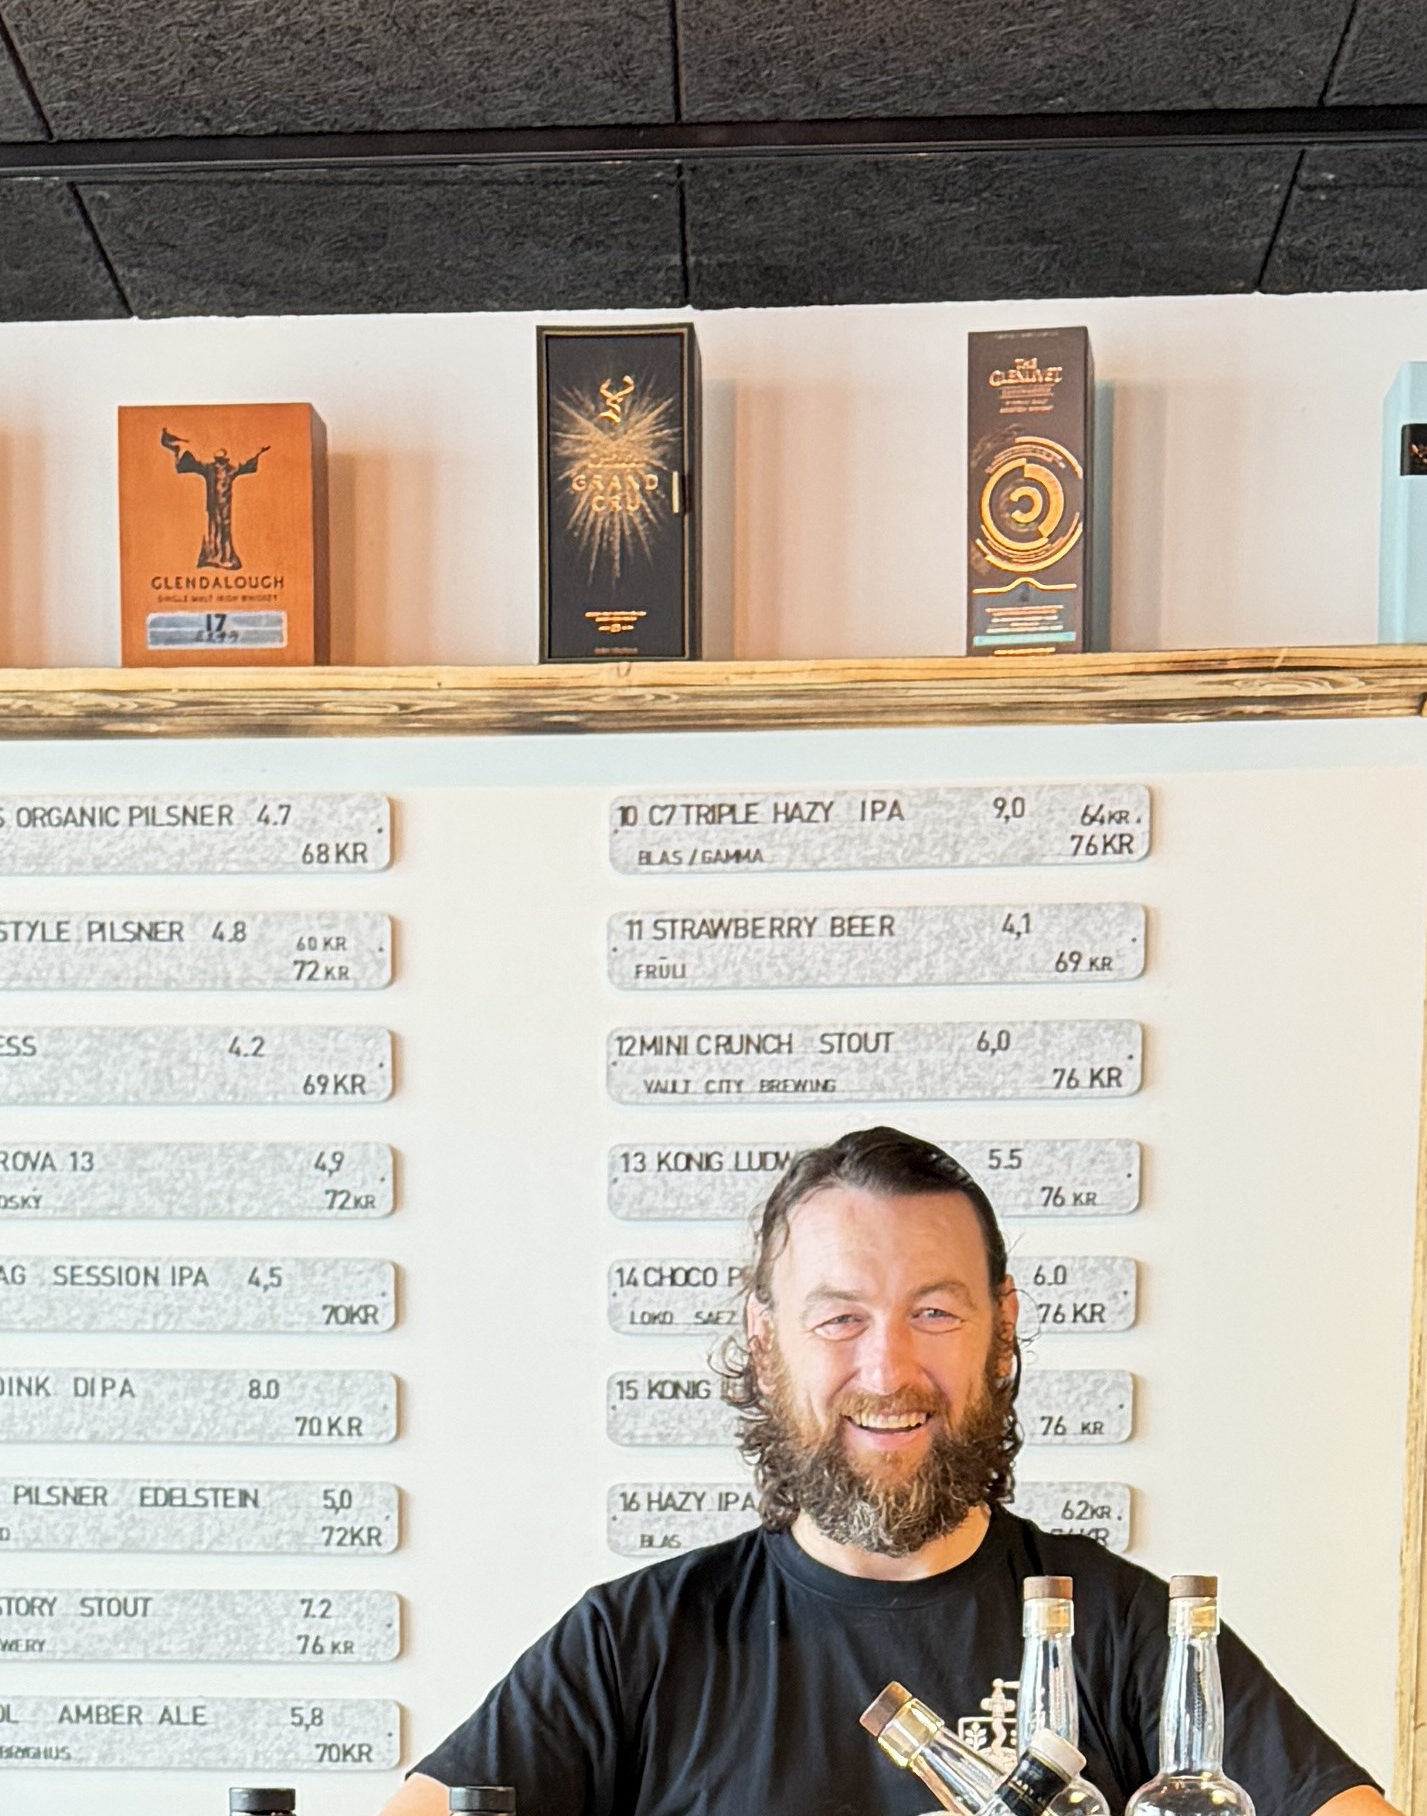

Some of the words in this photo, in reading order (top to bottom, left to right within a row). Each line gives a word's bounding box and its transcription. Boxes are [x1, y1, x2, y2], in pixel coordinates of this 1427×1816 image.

[572, 474, 659, 491] GRAND
[151, 575, 285, 591] GLENDALOUGH
[16, 805, 121, 828] ORGANIC
[128, 804, 234, 827] PILSNER
[256, 804, 292, 827] 4.7
[618, 805, 638, 827] 10
[684, 803, 759, 825] TRIPLE
[773, 801, 837, 824] HAZY
[860, 799, 905, 822] IPA
[87, 920, 184, 943] PILSNER
[211, 920, 247, 942] 4.8
[625, 919, 643, 941] 11
[652, 916, 818, 941] STRAWBERRY
[830, 915, 896, 938] BEER
[1055, 951, 1083, 973] 69
[1088, 956, 1113, 973] KR
[228, 1036, 266, 1058] 4.2
[639, 1034, 688, 1056] MINI
[819, 1031, 895, 1055] STOUT
[704, 1078, 744, 1094] CITY
[759, 1078, 837, 1094] BREWING
[1052, 1067, 1080, 1090] 76
[1089, 1066, 1123, 1089] KR
[69, 1150, 95, 1172] 13
[620, 1151, 646, 1173] 13
[657, 1151, 723, 1172] KONIG
[988, 1148, 1022, 1170] 5.5
[1041, 1185, 1066, 1207] 76
[1073, 1191, 1097, 1207] KR
[52, 1265, 160, 1288] SESSION
[171, 1266, 210, 1288] IPA
[615, 1266, 639, 1288] 14
[643, 1266, 718, 1288] CHOCO
[1038, 1303, 1065, 1325] 76
[1072, 1303, 1106, 1325] KR
[616, 1379, 639, 1401] 15
[647, 1378, 712, 1400] KONIG
[1040, 1415, 1067, 1436] 76
[1080, 1420, 1104, 1435] KR
[13, 1485, 108, 1507] PILSNER
[139, 1487, 259, 1509] EDELSTEIN
[620, 1491, 641, 1512] 16
[647, 1491, 706, 1512] HAZY
[717, 1491, 755, 1512] IPA
[79, 1597, 153, 1618] STOUT
[300, 1598, 333, 1619] 7.2
[296, 1635, 325, 1655] 76
[331, 1640, 355, 1655] KR
[58, 1704, 142, 1726] AMBER
[158, 1705, 207, 1726] ALE
